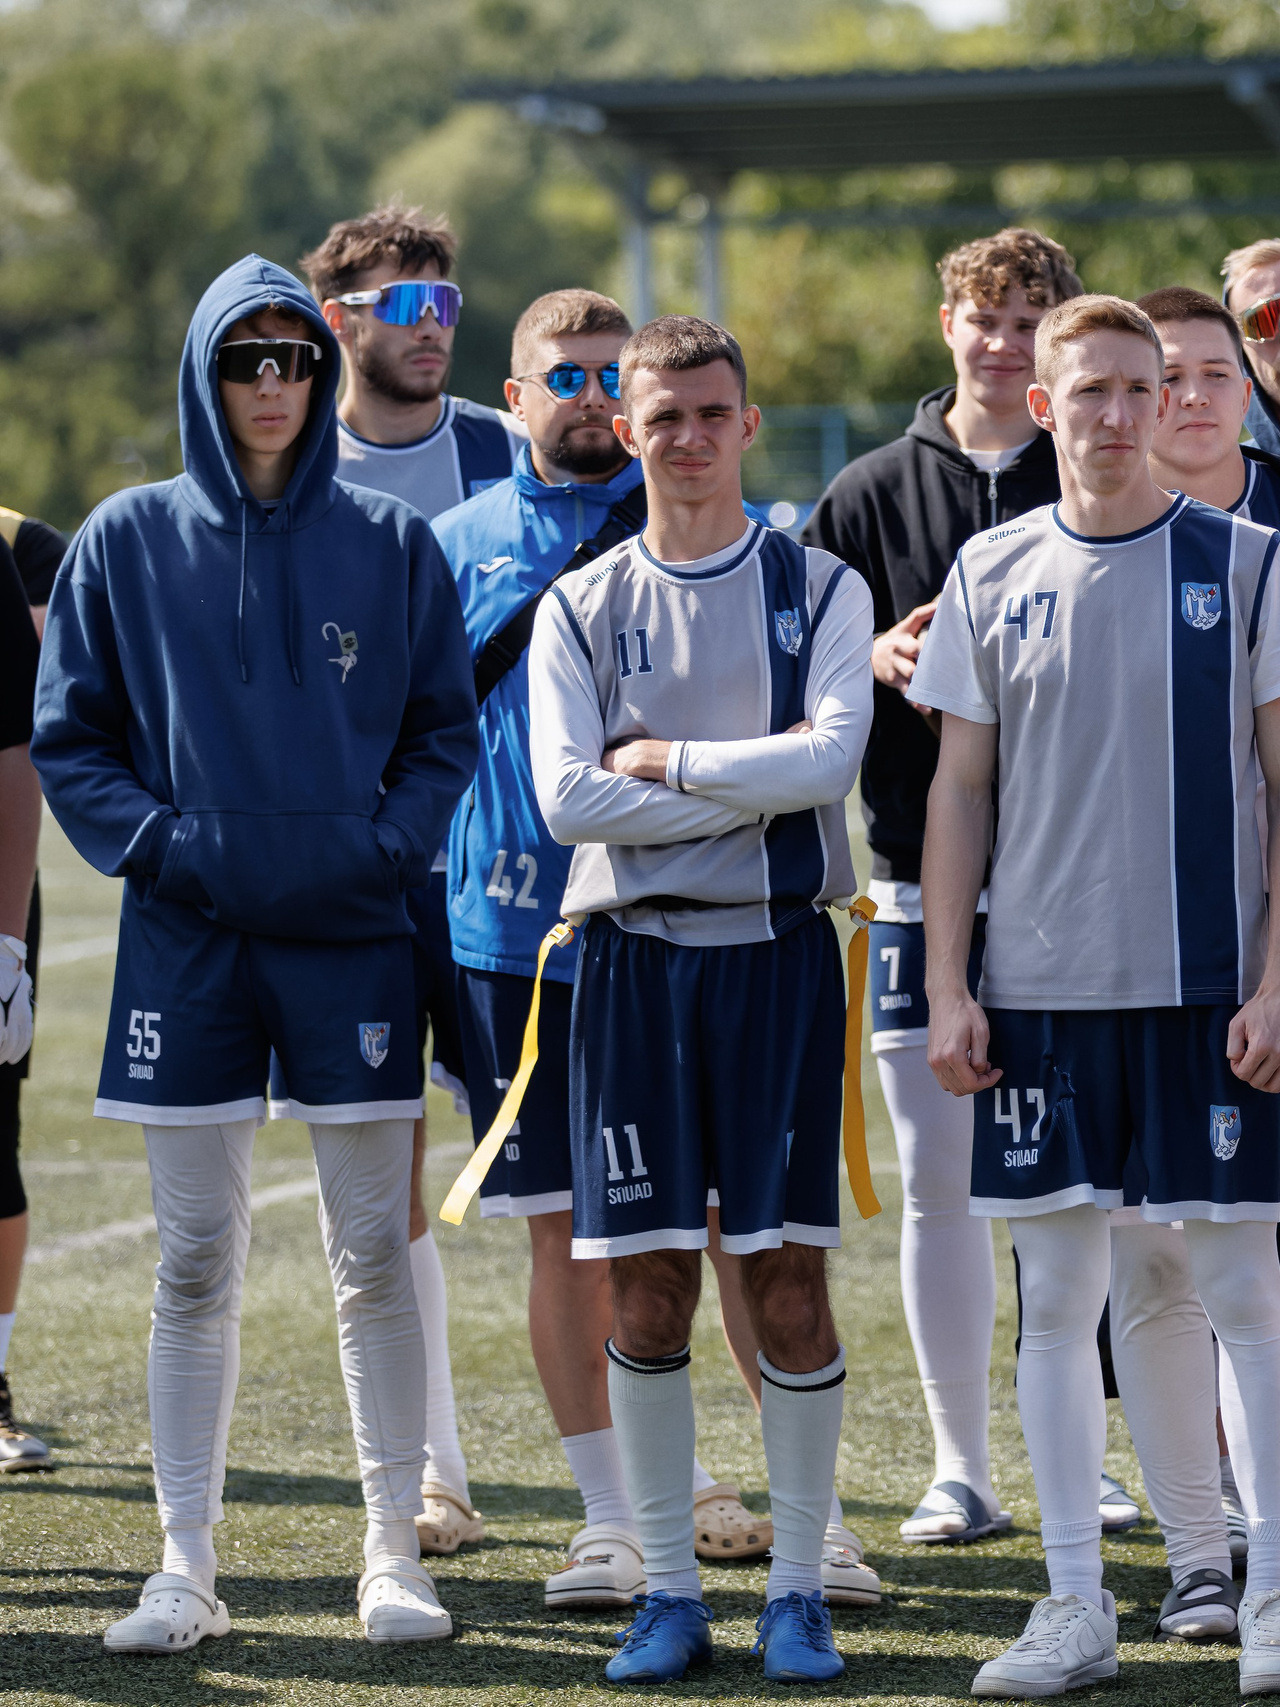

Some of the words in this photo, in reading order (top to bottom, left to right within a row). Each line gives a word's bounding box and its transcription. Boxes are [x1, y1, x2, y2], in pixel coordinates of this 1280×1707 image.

[1003, 590, 1060, 642] 47
[617, 627, 655, 681] 11
[485, 849, 540, 910] 42
[879, 945, 901, 992] 7
[126, 1008, 162, 1061] 55
[128, 1062, 155, 1081] SQUAD
[994, 1087, 1047, 1144] 47
[602, 1123, 649, 1182] 11
[607, 1181, 653, 1205] SQUAD
